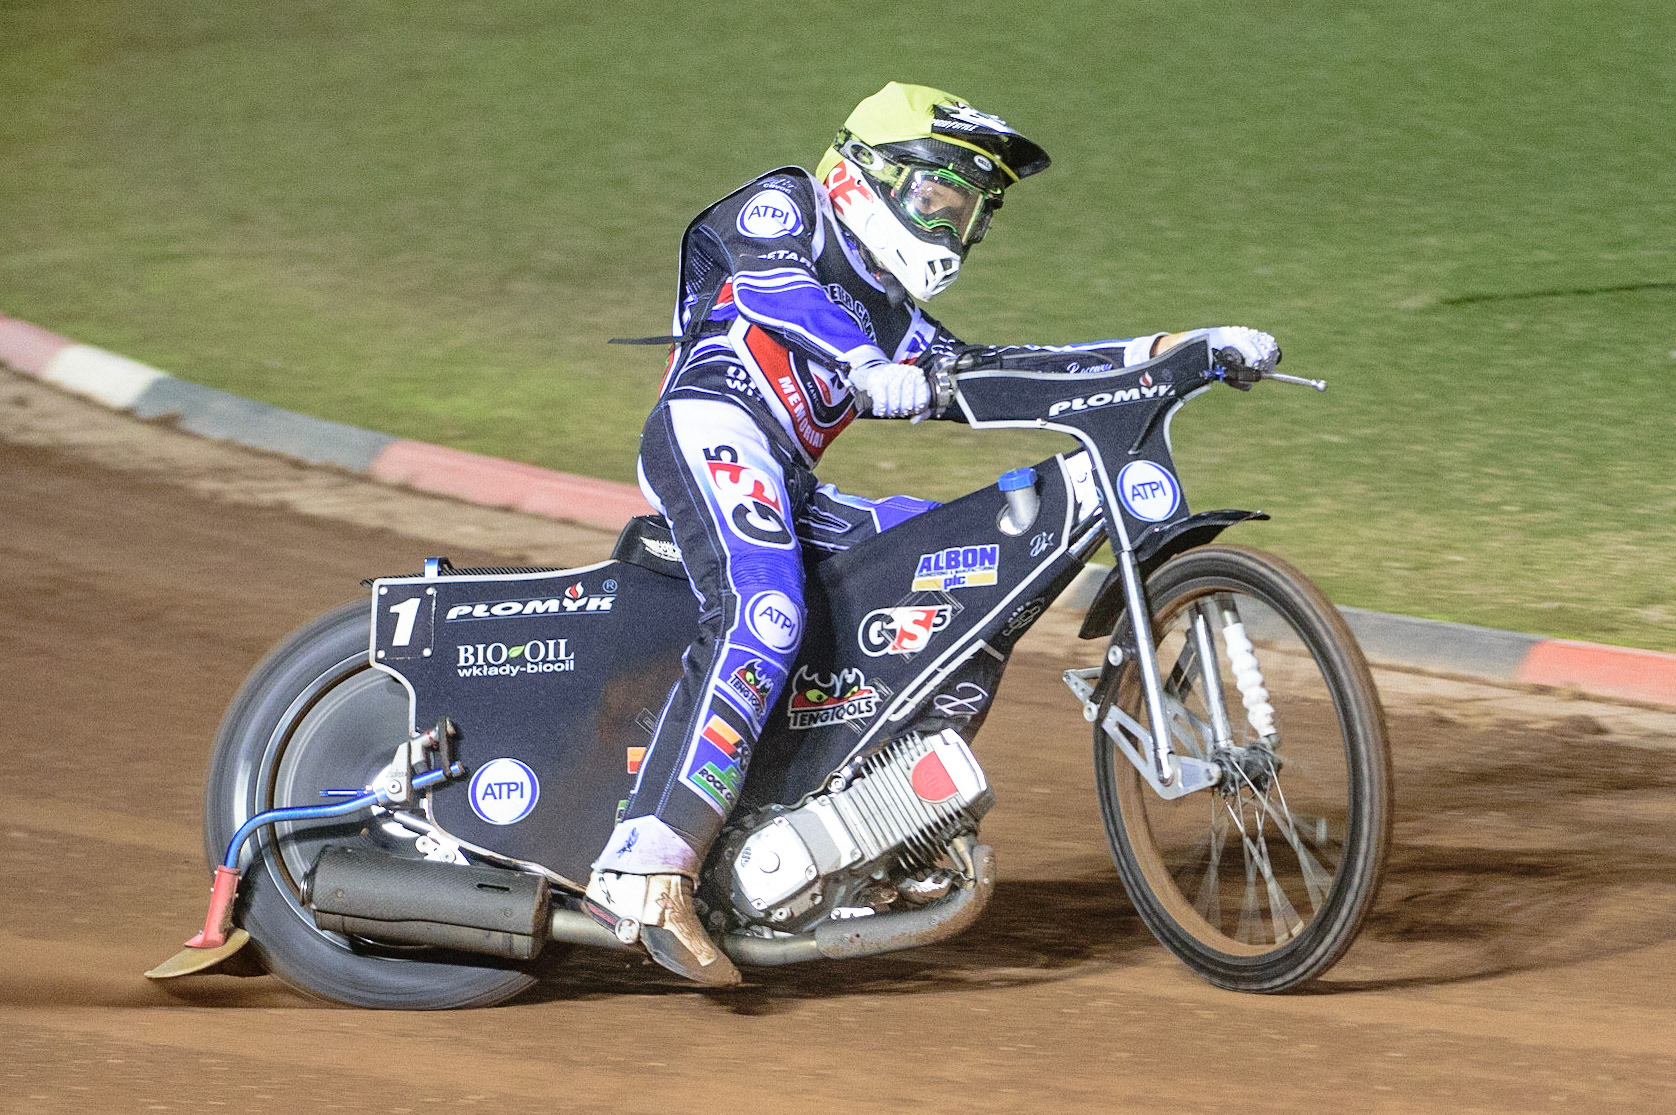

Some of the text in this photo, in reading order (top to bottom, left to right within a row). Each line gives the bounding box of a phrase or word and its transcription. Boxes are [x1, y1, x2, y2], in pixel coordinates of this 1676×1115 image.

[747, 205, 790, 225] ATPI
[1130, 480, 1167, 501] ATPI
[917, 546, 998, 574] ALBON
[943, 575, 967, 591] plc
[389, 597, 422, 647] 1
[758, 605, 796, 637] ATPI
[791, 700, 875, 728] TENGTOOLS
[481, 780, 525, 801] ATPI
